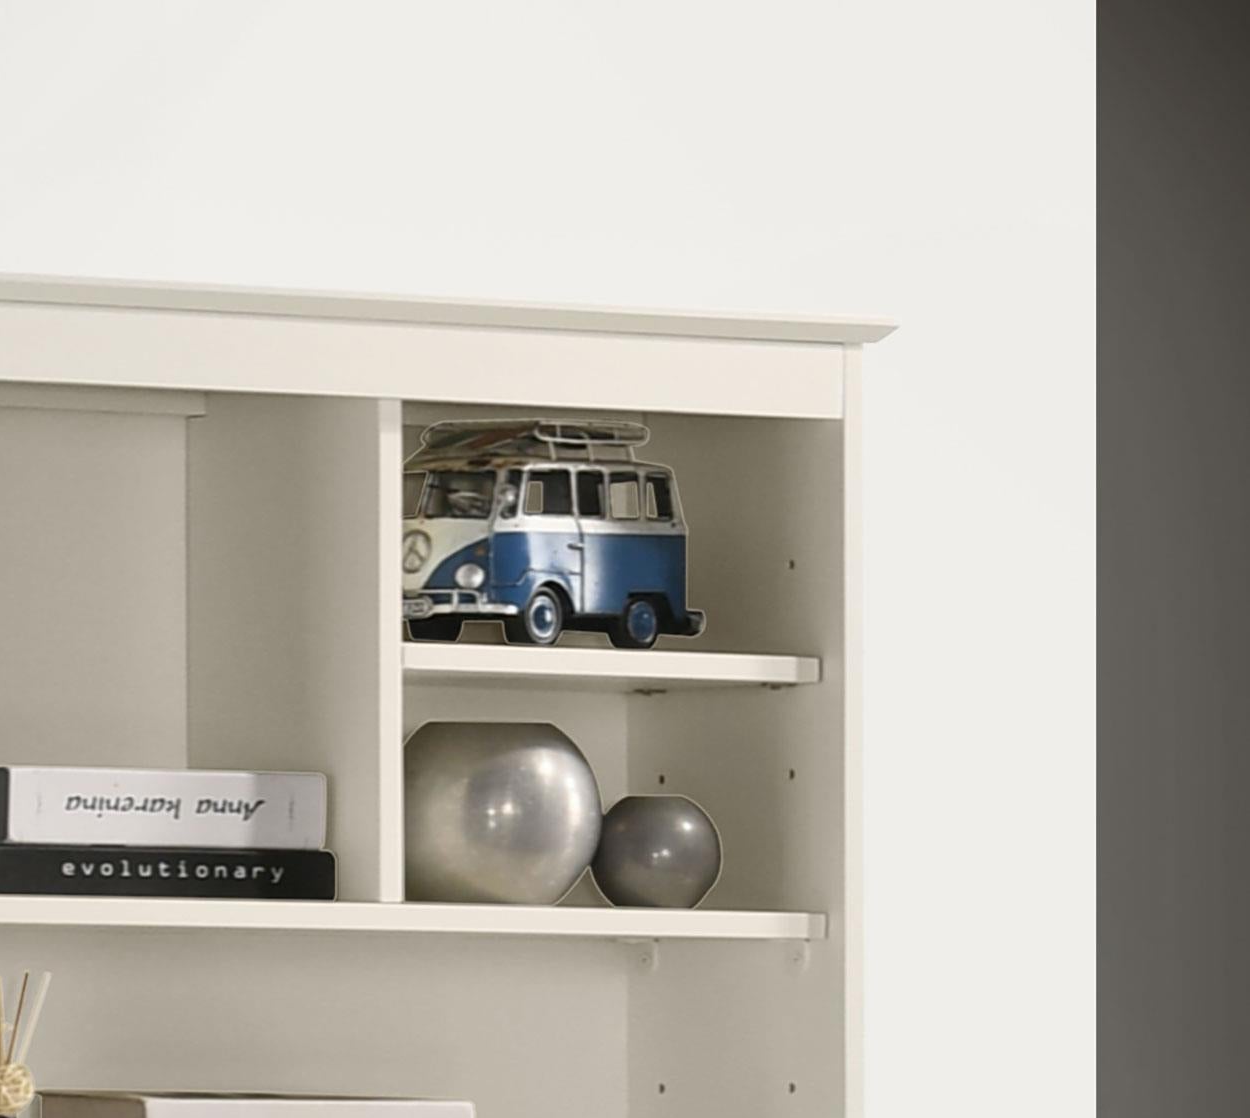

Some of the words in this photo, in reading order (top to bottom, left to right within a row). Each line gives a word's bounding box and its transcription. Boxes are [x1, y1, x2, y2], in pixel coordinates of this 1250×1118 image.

[64, 796, 181, 820] karenina
[195, 799, 266, 821] Anna
[61, 860, 286, 884] evolutionary
